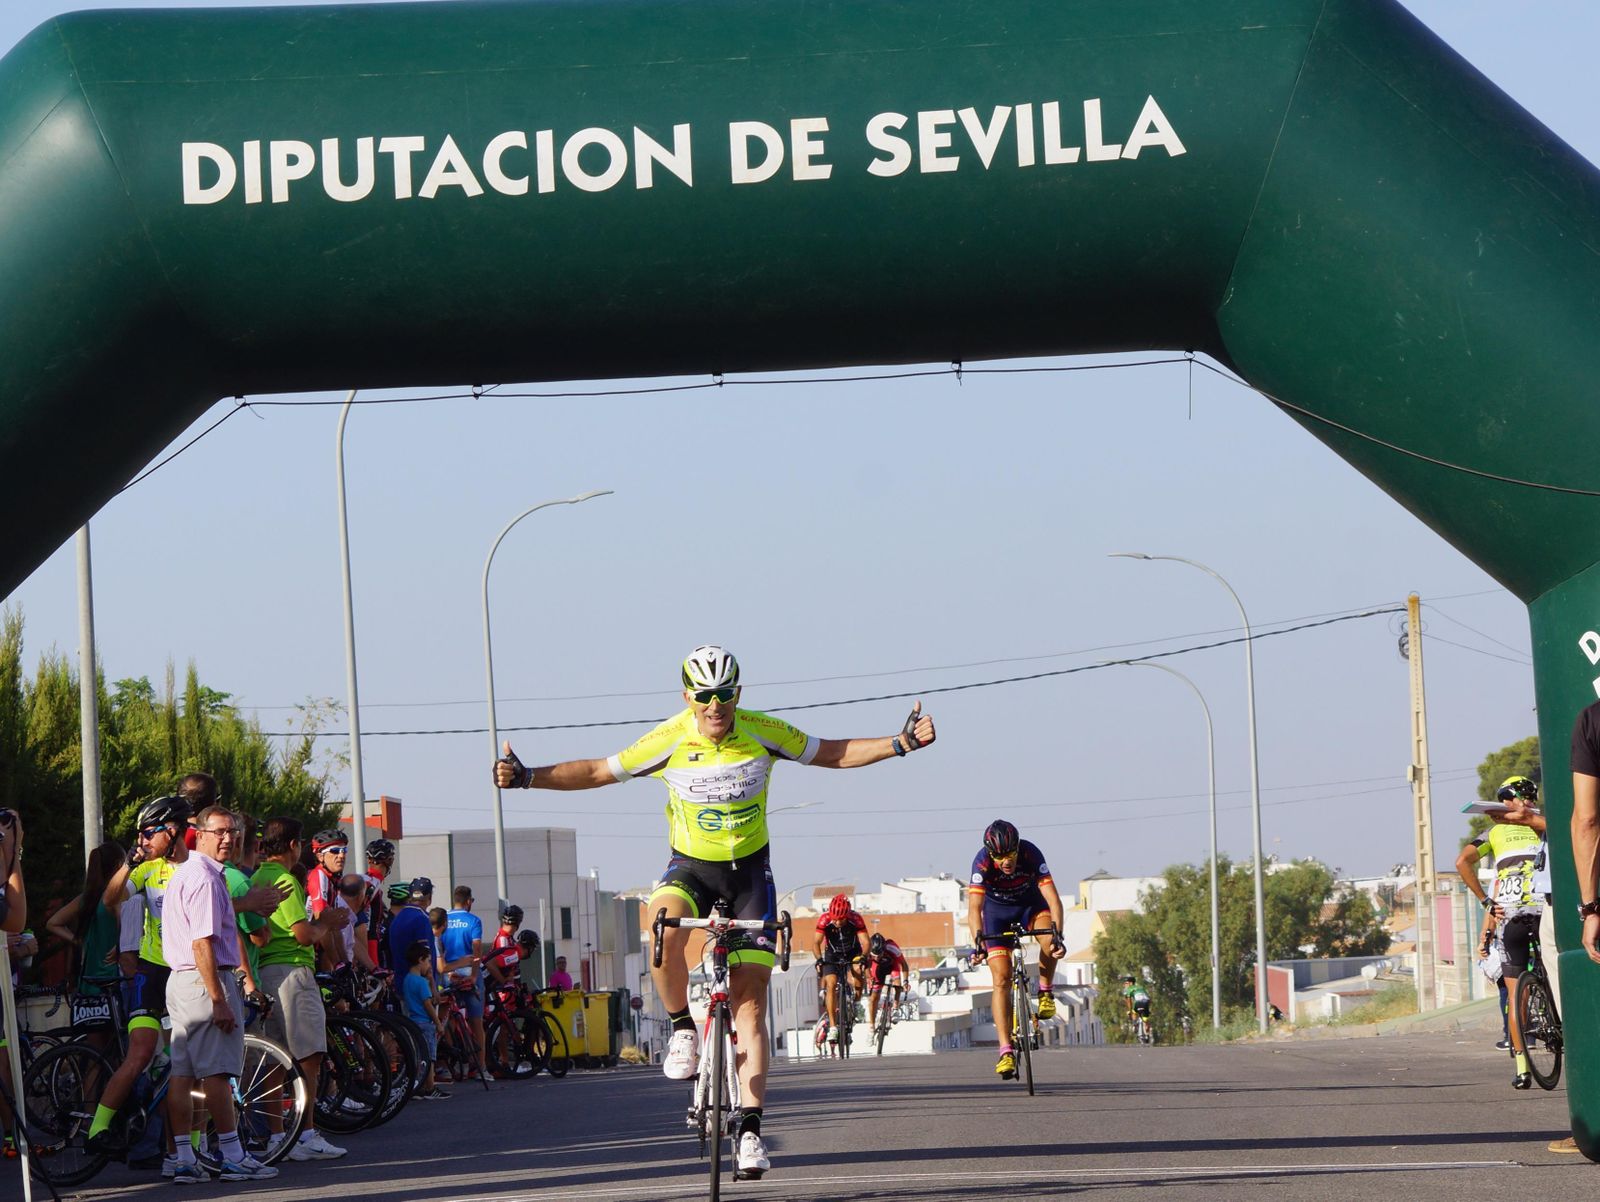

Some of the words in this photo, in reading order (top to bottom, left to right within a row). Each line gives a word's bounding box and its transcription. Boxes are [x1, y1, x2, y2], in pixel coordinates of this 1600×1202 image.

[182, 123, 693, 204] DIPUTACION
[729, 117, 833, 184] DE
[866, 95, 1187, 177] SEVILLA
[689, 779, 757, 793] Castillo
[1499, 877, 1522, 897] 203
